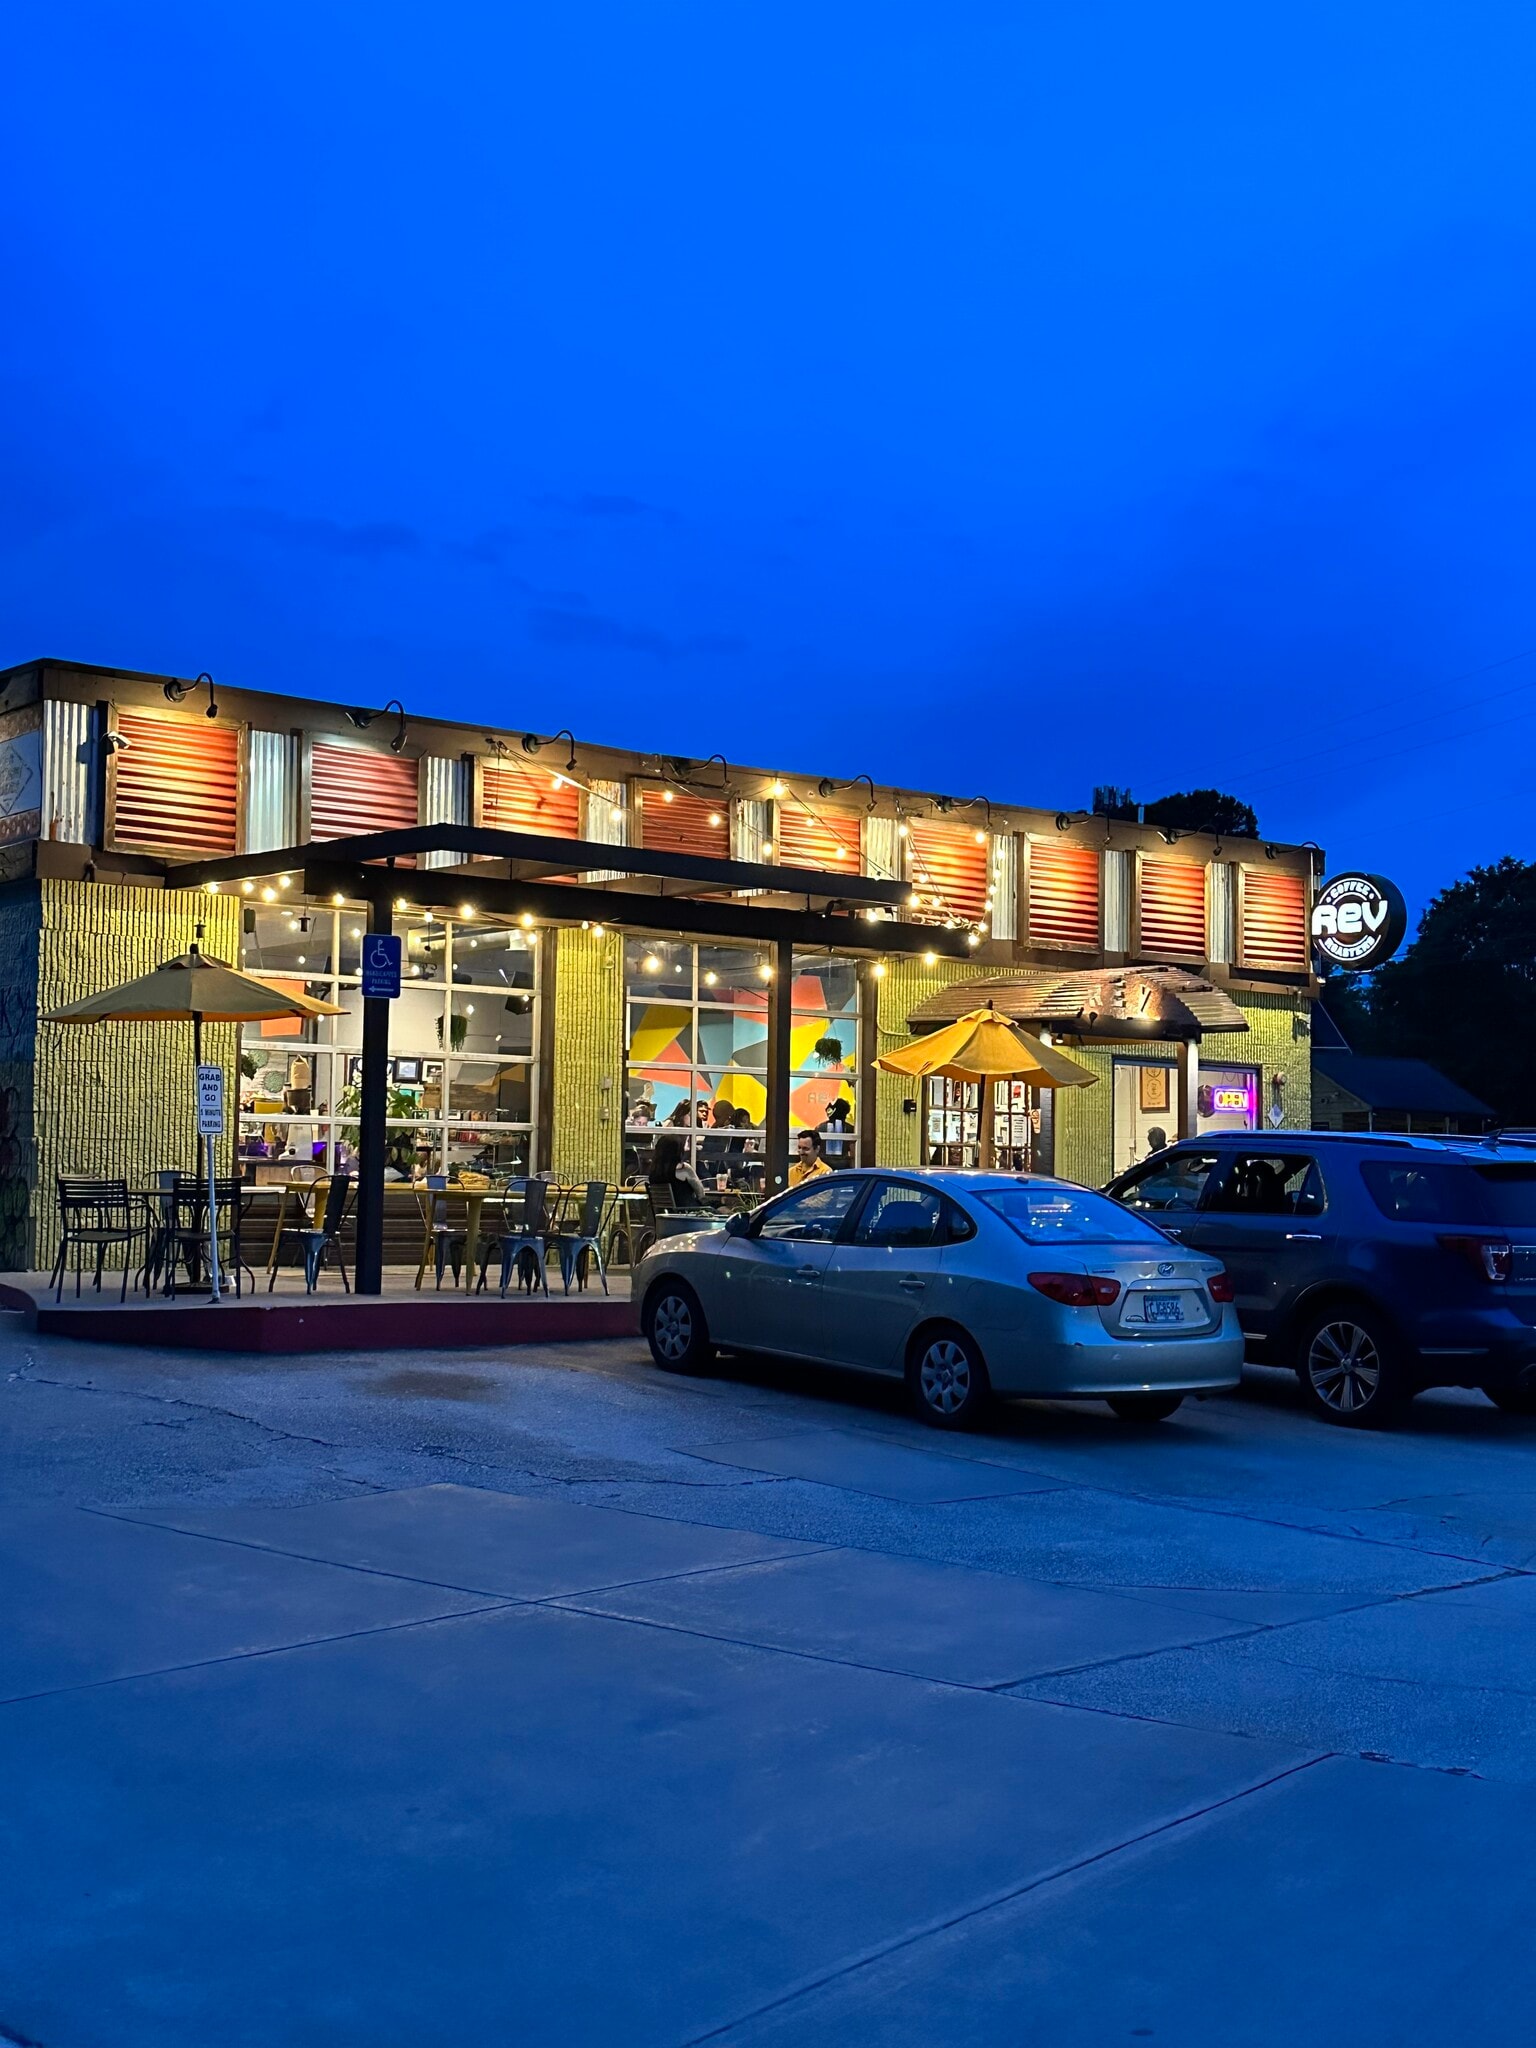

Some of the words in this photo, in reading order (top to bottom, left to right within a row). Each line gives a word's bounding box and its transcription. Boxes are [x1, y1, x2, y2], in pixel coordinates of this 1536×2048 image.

[1330, 881, 1370, 898] COFFEE
[1324, 936, 1376, 957] ROASTERS
[199, 1073, 221, 1081] GRAB
[202, 1083, 219, 1091] AND
[1216, 1091, 1247, 1108] OPEN
